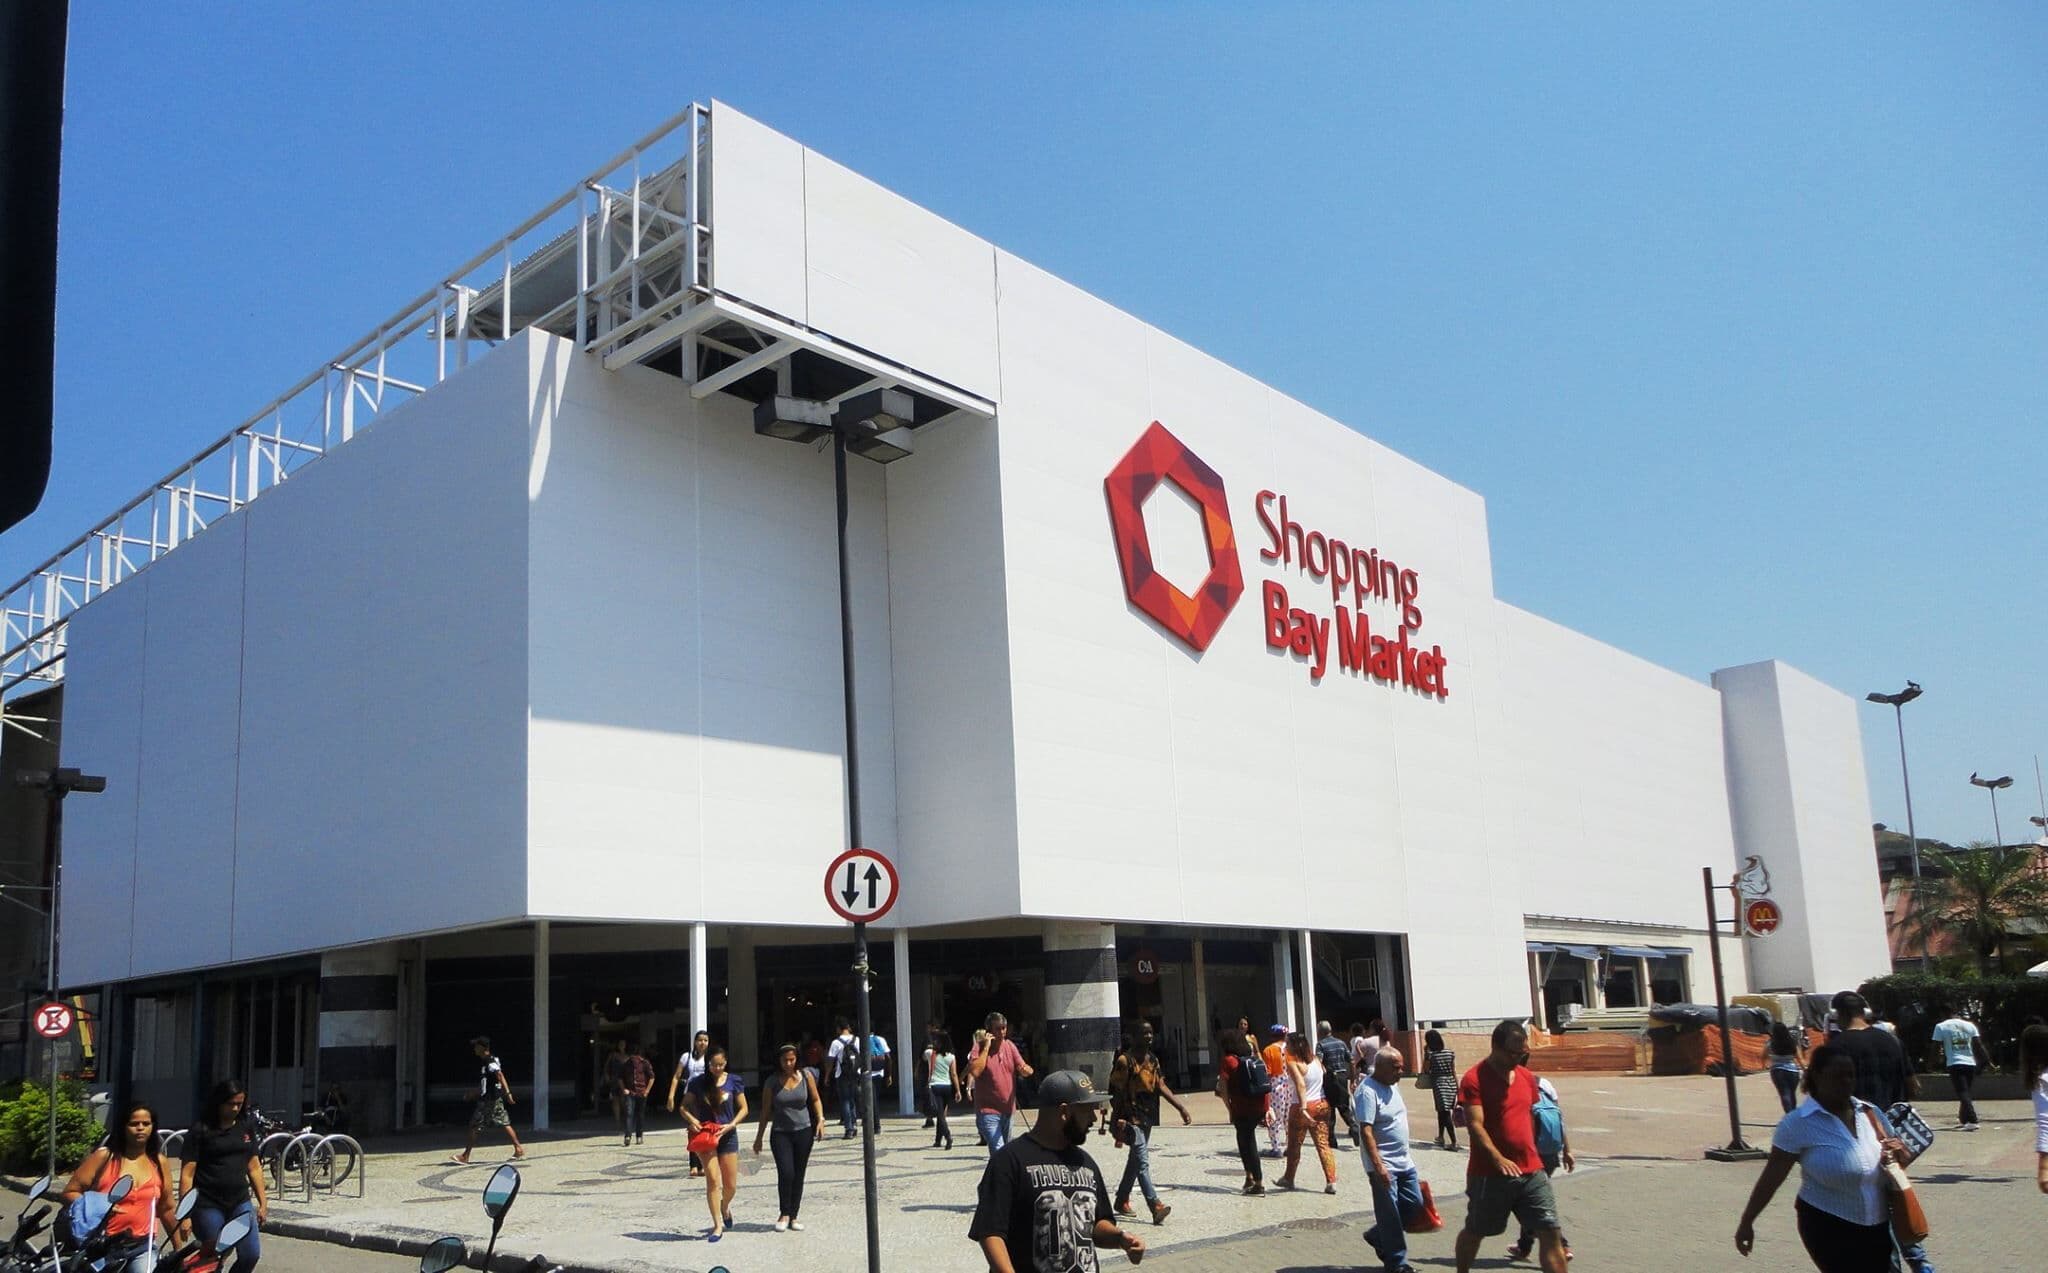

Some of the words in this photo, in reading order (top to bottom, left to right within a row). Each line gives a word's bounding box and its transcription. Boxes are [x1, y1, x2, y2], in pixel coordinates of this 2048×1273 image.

[1256, 489, 1423, 630] Shopping
[1262, 579, 1330, 679] Bay
[1335, 605, 1449, 697] Market
